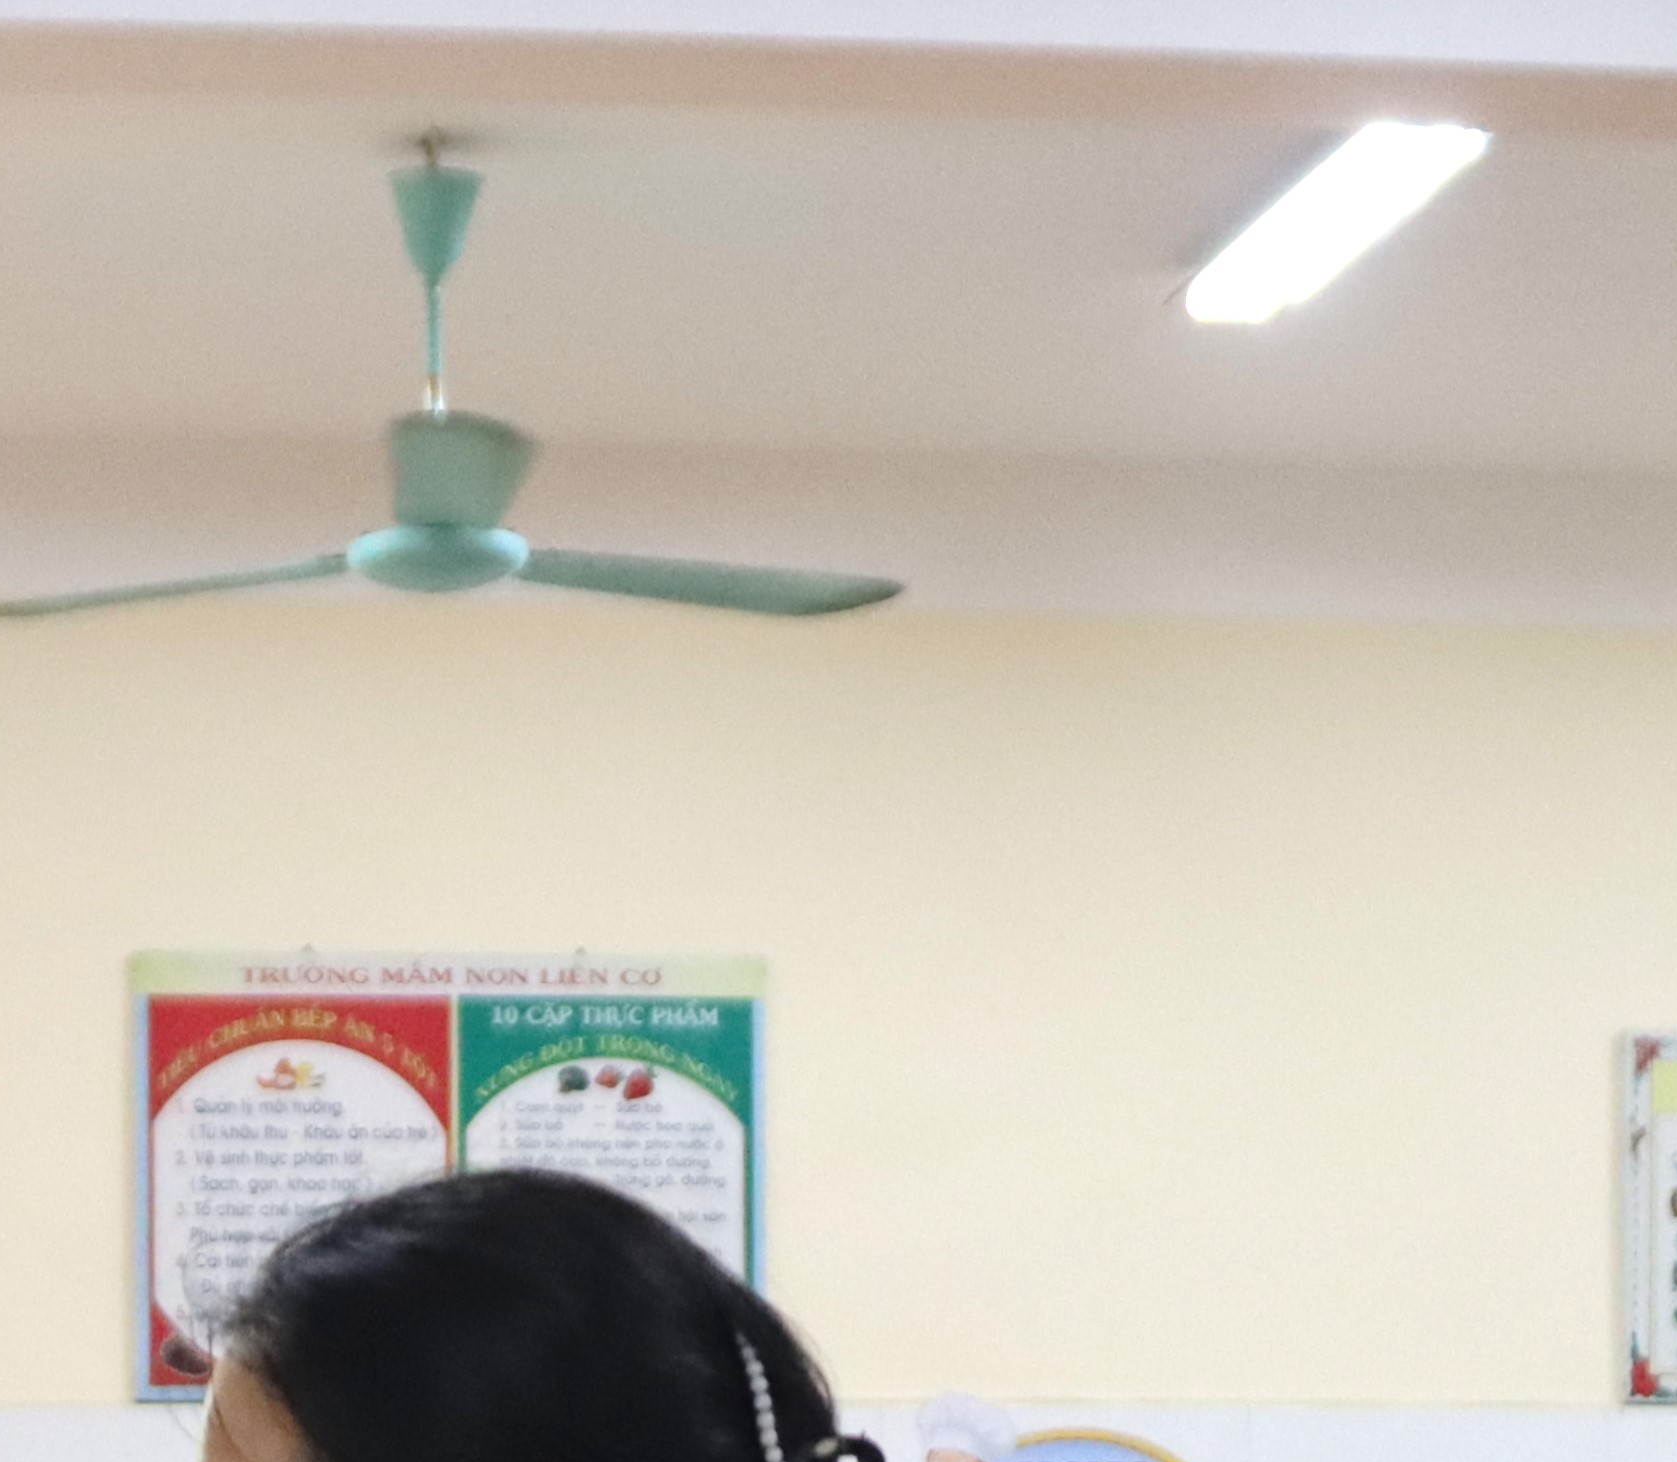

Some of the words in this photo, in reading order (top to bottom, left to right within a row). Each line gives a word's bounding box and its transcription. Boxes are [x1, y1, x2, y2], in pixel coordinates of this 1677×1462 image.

[465, 967, 528, 985] NON
[540, 961, 608, 985] LIÊN
[619, 965, 664, 985] CƠ
[491, 1006, 520, 1025] 10
[526, 1001, 573, 1028] CẶP
[580, 1003, 645, 1029] THỰC
[650, 1000, 720, 1027] PHẨM
